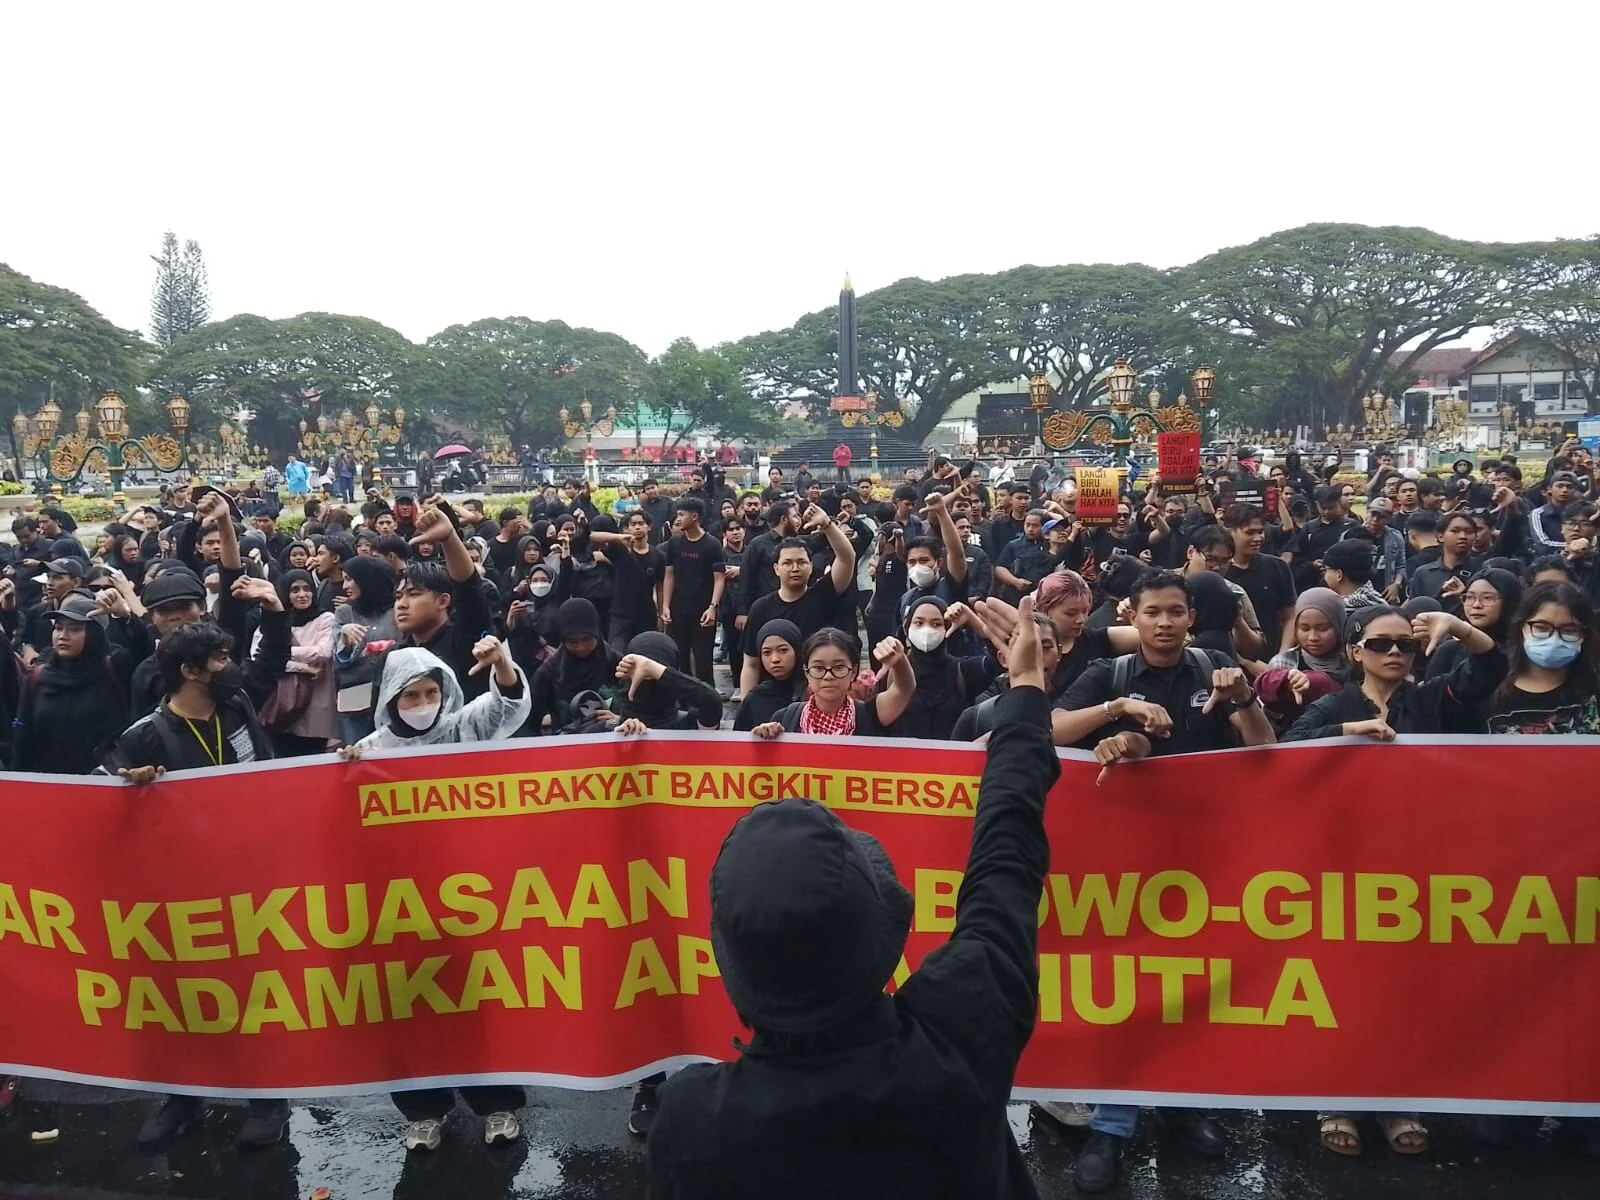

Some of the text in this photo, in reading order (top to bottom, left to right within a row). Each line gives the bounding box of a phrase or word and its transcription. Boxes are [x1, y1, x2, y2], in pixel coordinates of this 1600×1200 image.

[1080, 479, 1100, 488] BIRU
[1080, 488, 1112, 498] ADALAH
[1080, 498, 1116, 507] HAK KITA
[361, 780, 506, 819] ALIANSI
[518, 769, 660, 807] RAKYAT
[670, 771, 834, 801] BANGKIT
[100, 856, 689, 963] KEKUASAAN
[75, 945, 583, 1035] PADAMKAN
[614, 934, 722, 1010] AP
